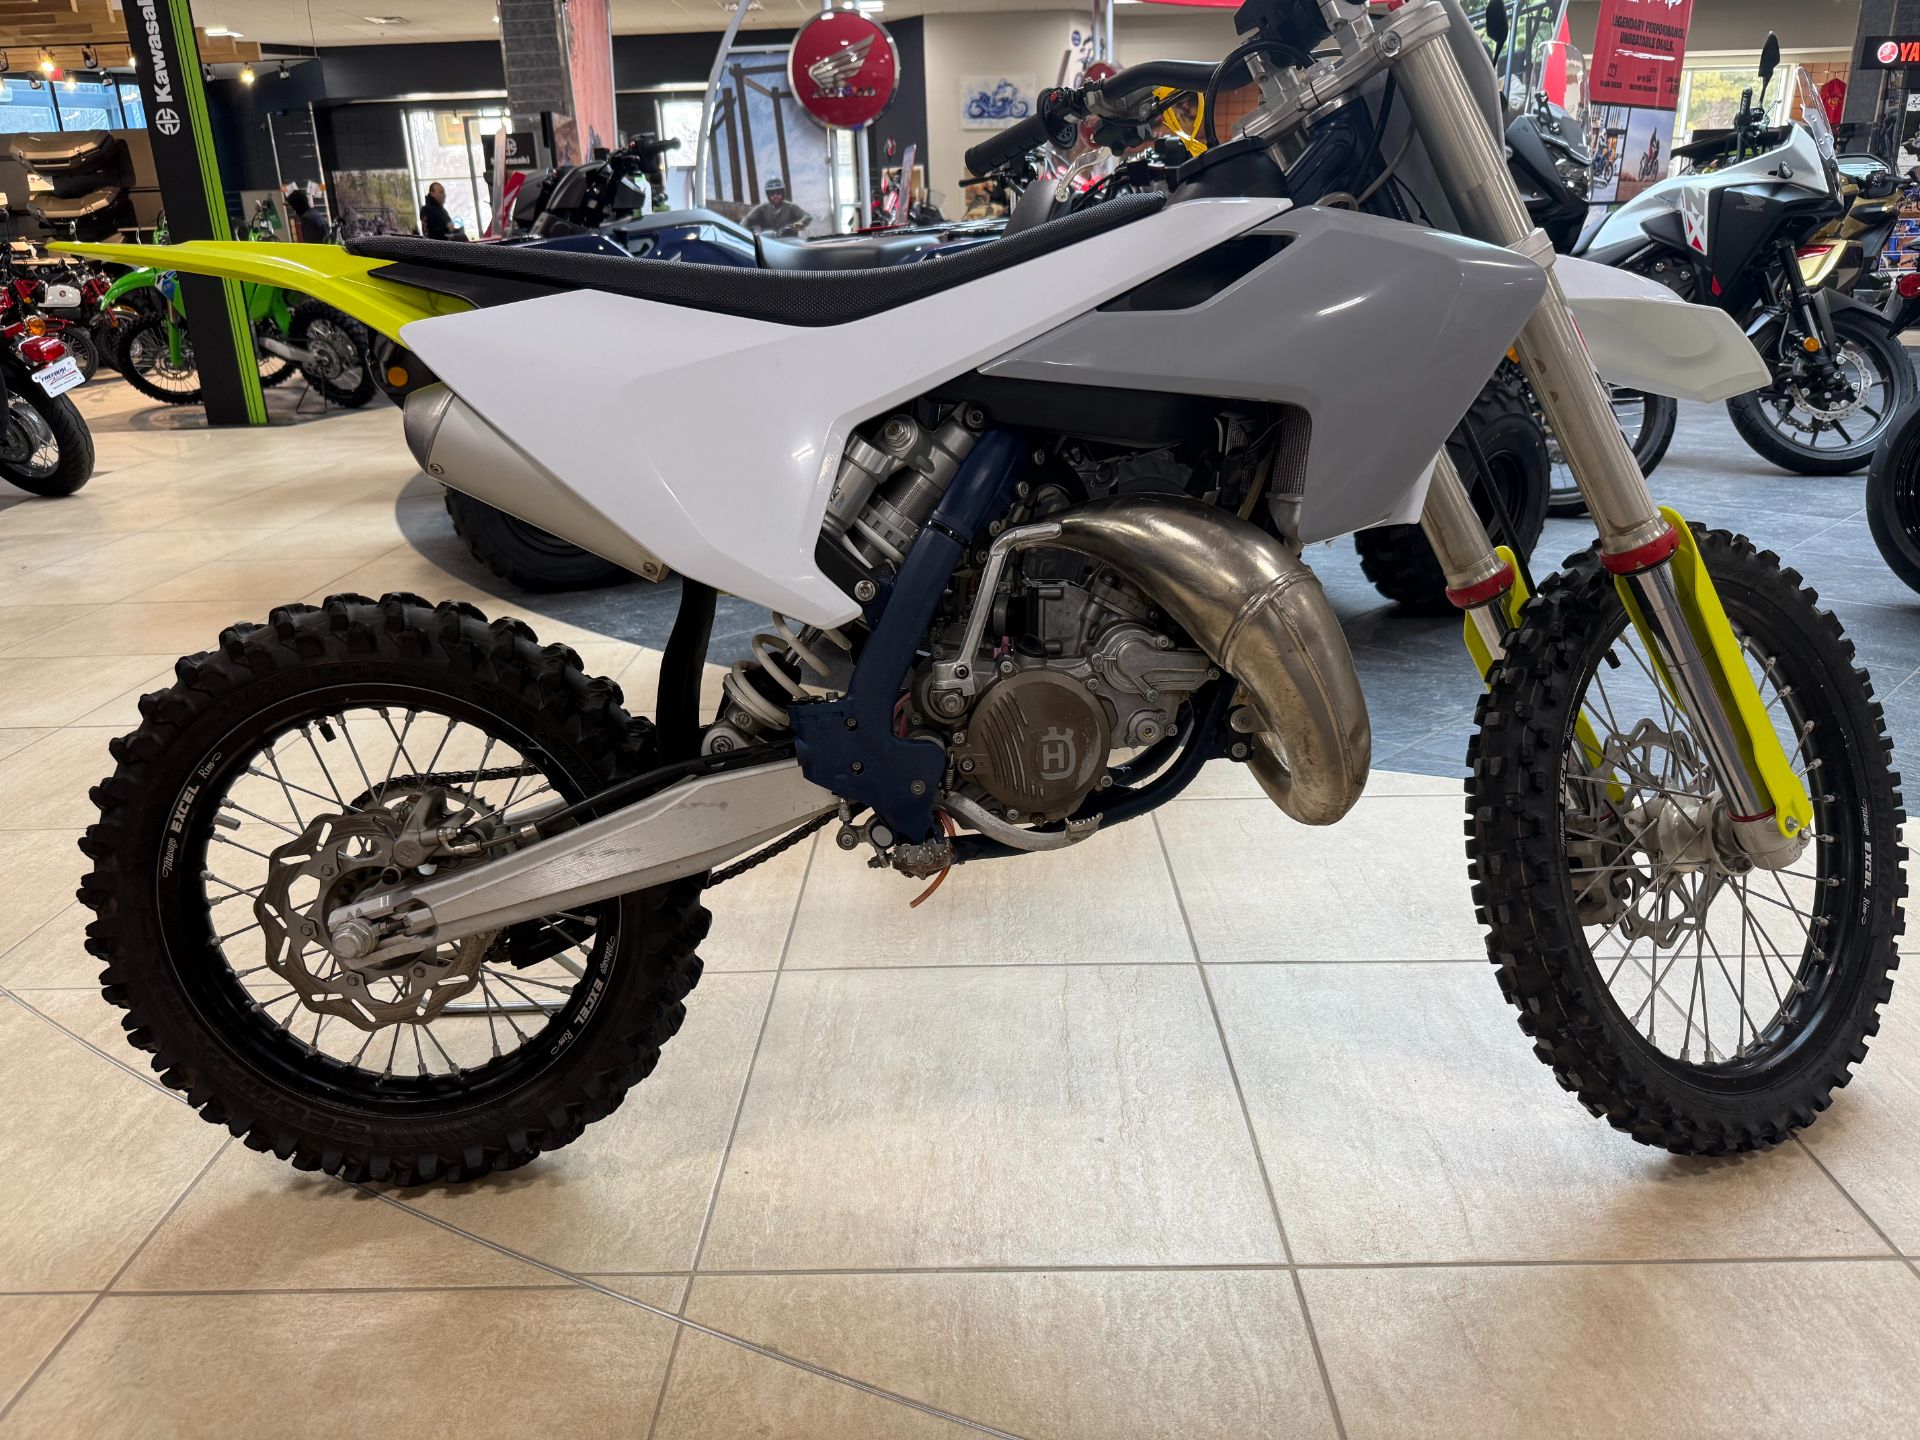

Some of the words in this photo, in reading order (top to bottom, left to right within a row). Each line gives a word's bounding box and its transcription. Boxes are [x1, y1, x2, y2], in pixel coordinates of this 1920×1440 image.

[1612, 14, 1645, 32] LEGENDARY
[1620, 32, 1656, 48] UNBEATABLE
[170, 785, 200, 833] EXCEL
[198, 752, 221, 779] Rim
[1864, 841, 1872, 890] EXCEL
[1861, 897, 1871, 926] Rim
[574, 978, 604, 1024] EXCEL
